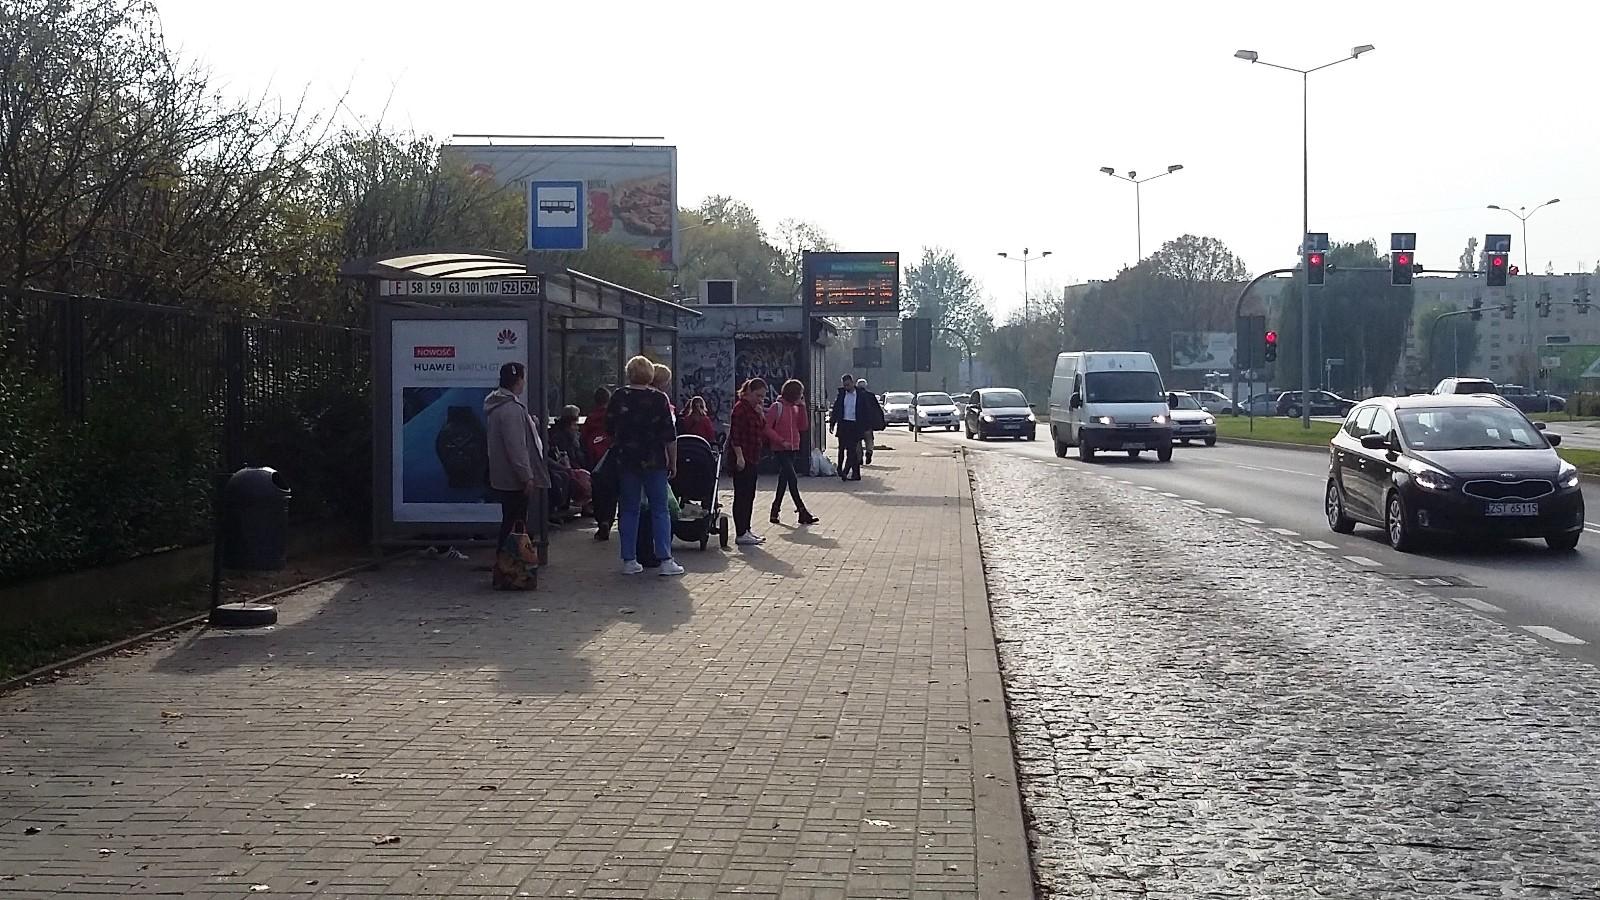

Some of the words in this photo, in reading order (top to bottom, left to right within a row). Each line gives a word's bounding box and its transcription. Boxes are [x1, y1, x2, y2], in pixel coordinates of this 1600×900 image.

[395, 281, 402, 293] F
[411, 282, 423, 293] 58
[430, 282, 442, 293] 59
[448, 282, 460, 293] 63
[466, 282, 480, 293] 101
[484, 282, 499, 293] 107
[502, 281, 518, 294] 523
[521, 281, 537, 294] 524
[414, 362, 455, 372] HUAWEI
[458, 362, 487, 372] WATCH
[1489, 503, 1506, 514] ZST
[1510, 503, 1537, 513] 65115
